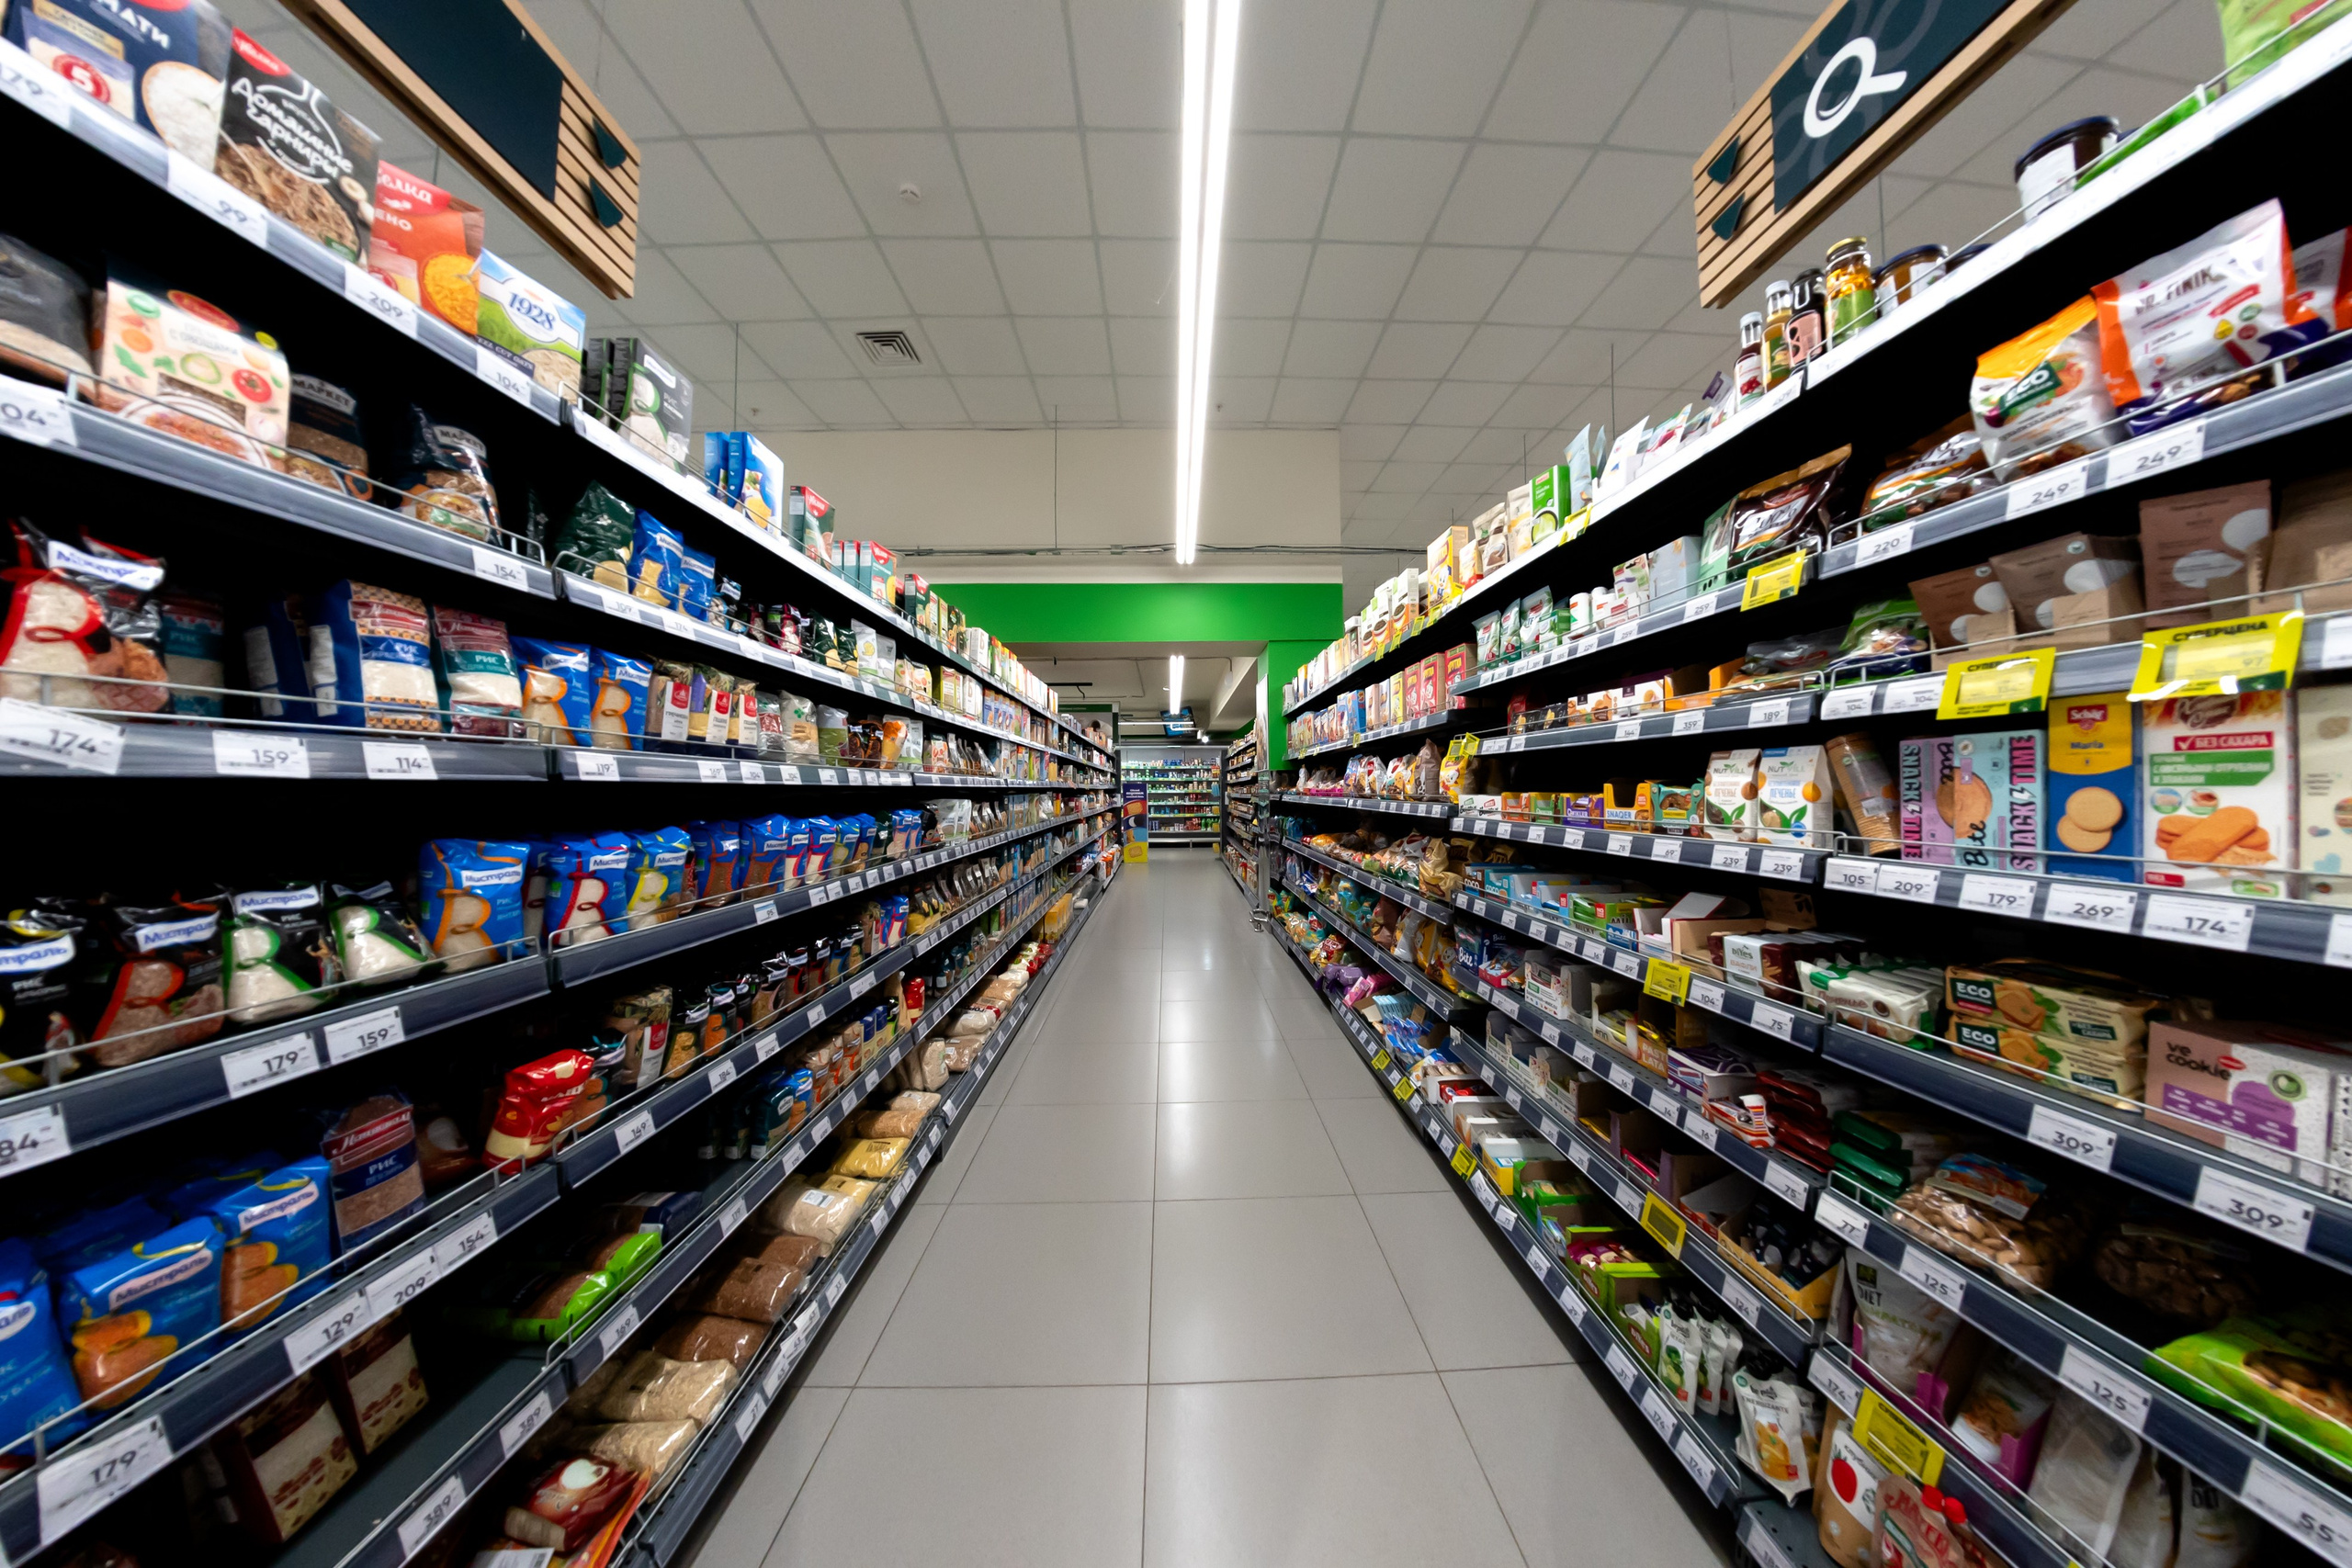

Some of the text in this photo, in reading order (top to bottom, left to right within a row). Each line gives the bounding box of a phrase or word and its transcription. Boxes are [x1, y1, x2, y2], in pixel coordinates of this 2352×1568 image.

[368, 292, 403, 318] 209
[508, 291, 556, 331] 1928
[497, 372, 520, 392] 104
[2137, 445, 2181, 470] 249
[2031, 484, 2069, 504] 249
[1874, 538, 1899, 553] 220
[493, 563, 517, 580] 154
[2173, 621, 2268, 642] СУПЕРЦЕНА
[475, 655, 499, 664] РИС
[1682, 720, 1698, 730] 359
[1763, 711, 1780, 721] 189
[48, 728, 96, 753] 174
[2070, 740, 2104, 750] Maria
[2195, 735, 2269, 748] БЕЗ САХАРА
[251, 748, 288, 764] 159
[395, 757, 422, 770] 114
[1902, 745, 1922, 858] SNACK TIME
[2009, 735, 2038, 872] SNACK TIME
[1607, 810, 1632, 819] SNAQER
[1964, 820, 1989, 866] Bite
[1723, 857, 1740, 867] 239
[1774, 863, 1792, 874] 239
[1843, 874, 1865, 885] 105
[1894, 881, 1924, 892] 209
[242, 888, 316, 908] Мистраль
[1988, 891, 2017, 906] 179
[2073, 903, 2113, 918] 269
[2185, 917, 2226, 934] 174
[1459, 947, 1473, 965] Bite
[1702, 994, 1714, 1005] 104
[1956, 982, 1992, 998] ECO
[1771, 1019, 1782, 1030] 75
[356, 1029, 388, 1047] 159
[1962, 1027, 1996, 1044] ECO
[2166, 1042, 2192, 1056] ve
[262, 1052, 299, 1073] 179
[1643, 1056, 1665, 1072] LATA
[2166, 1054, 2232, 1080] cookie
[631, 1122, 647, 1138] 149
[1701, 1129, 1710, 1140] 16
[2053, 1131, 2094, 1155] 309
[368, 1154, 397, 1175] РИС
[1785, 1184, 1797, 1199] 75
[2230, 1198, 2284, 1228] 309
[459, 1230, 484, 1251] 154
[116, 1254, 209, 1303] Мистраль
[1925, 1273, 1948, 1295] 125
[394, 1278, 425, 1303] 209
[1860, 1285, 1882, 1306] DIET
[322, 1313, 354, 1340] 129
[615, 1317, 632, 1337] 169
[2092, 1381, 2126, 1411] 125
[518, 1406, 542, 1429] 389
[91, 1450, 136, 1483] 179
[423, 1495, 452, 1525] 389
[2299, 1512, 2335, 1543] 55
